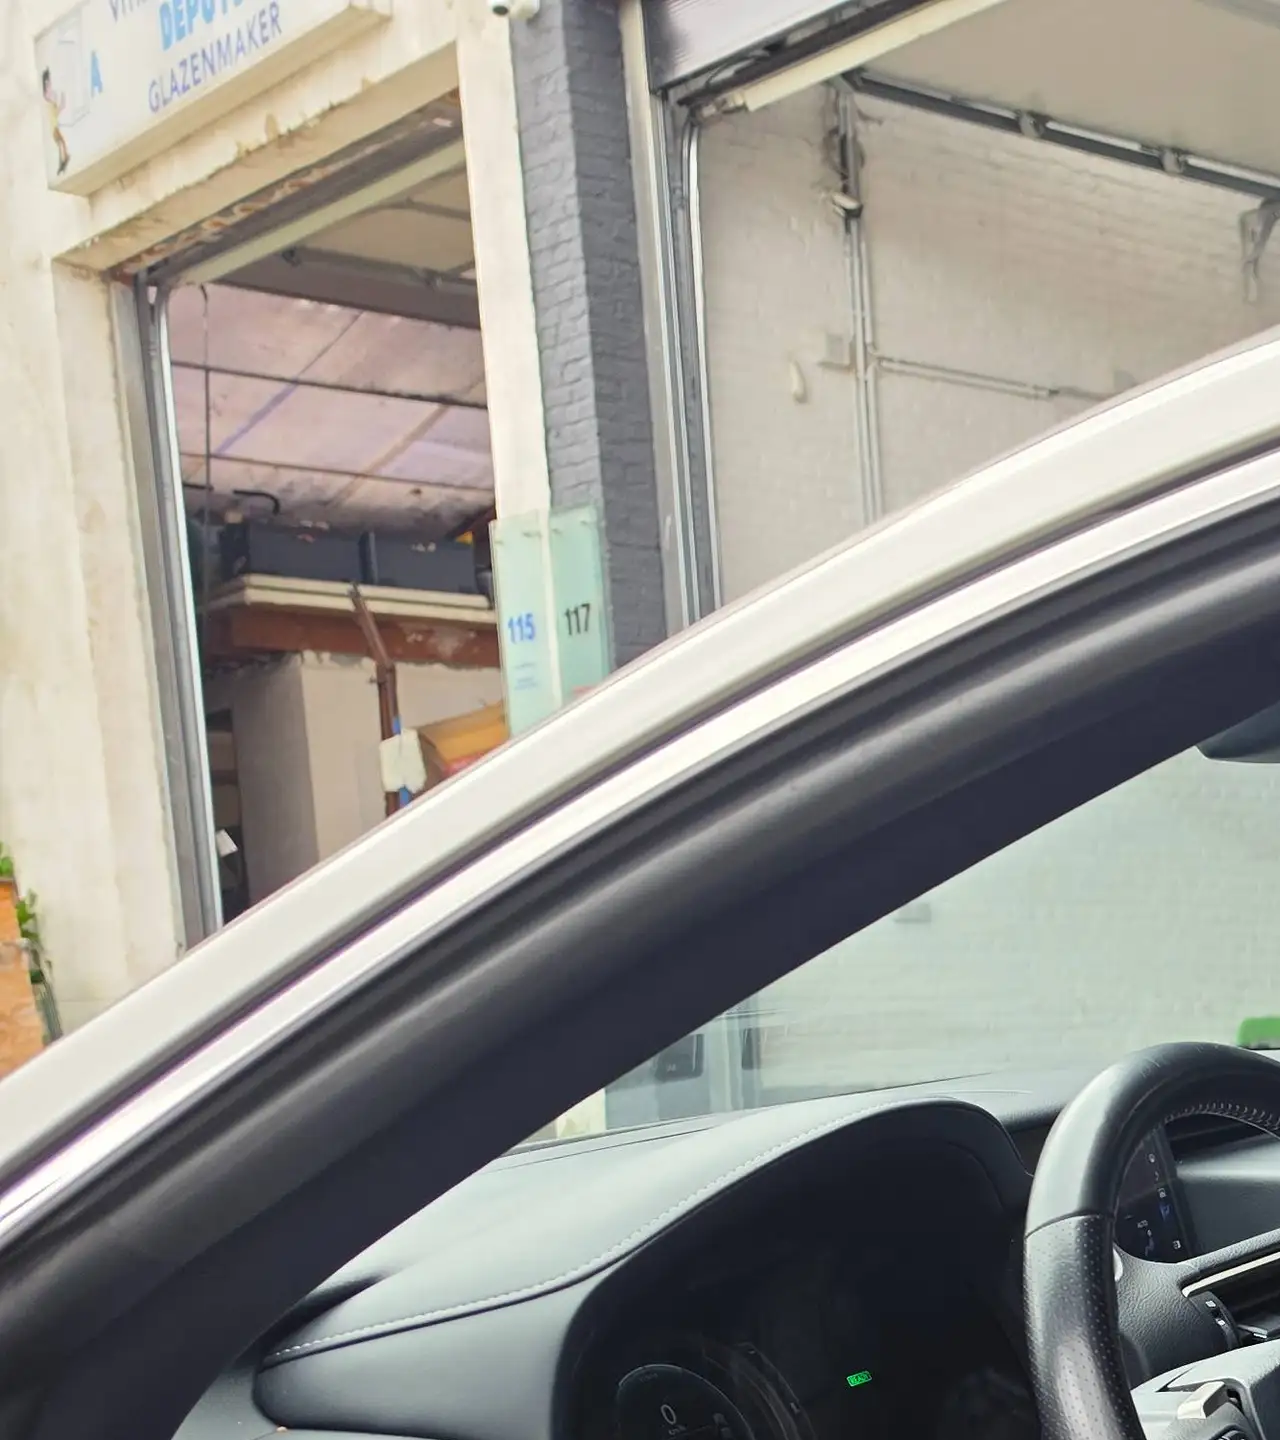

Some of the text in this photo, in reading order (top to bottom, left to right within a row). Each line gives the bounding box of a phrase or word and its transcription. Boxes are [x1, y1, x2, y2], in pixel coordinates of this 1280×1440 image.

[149, 1, 282, 114] GLAZENMAKER
[507, 612, 537, 644] 115
[565, 603, 591, 636] 117
